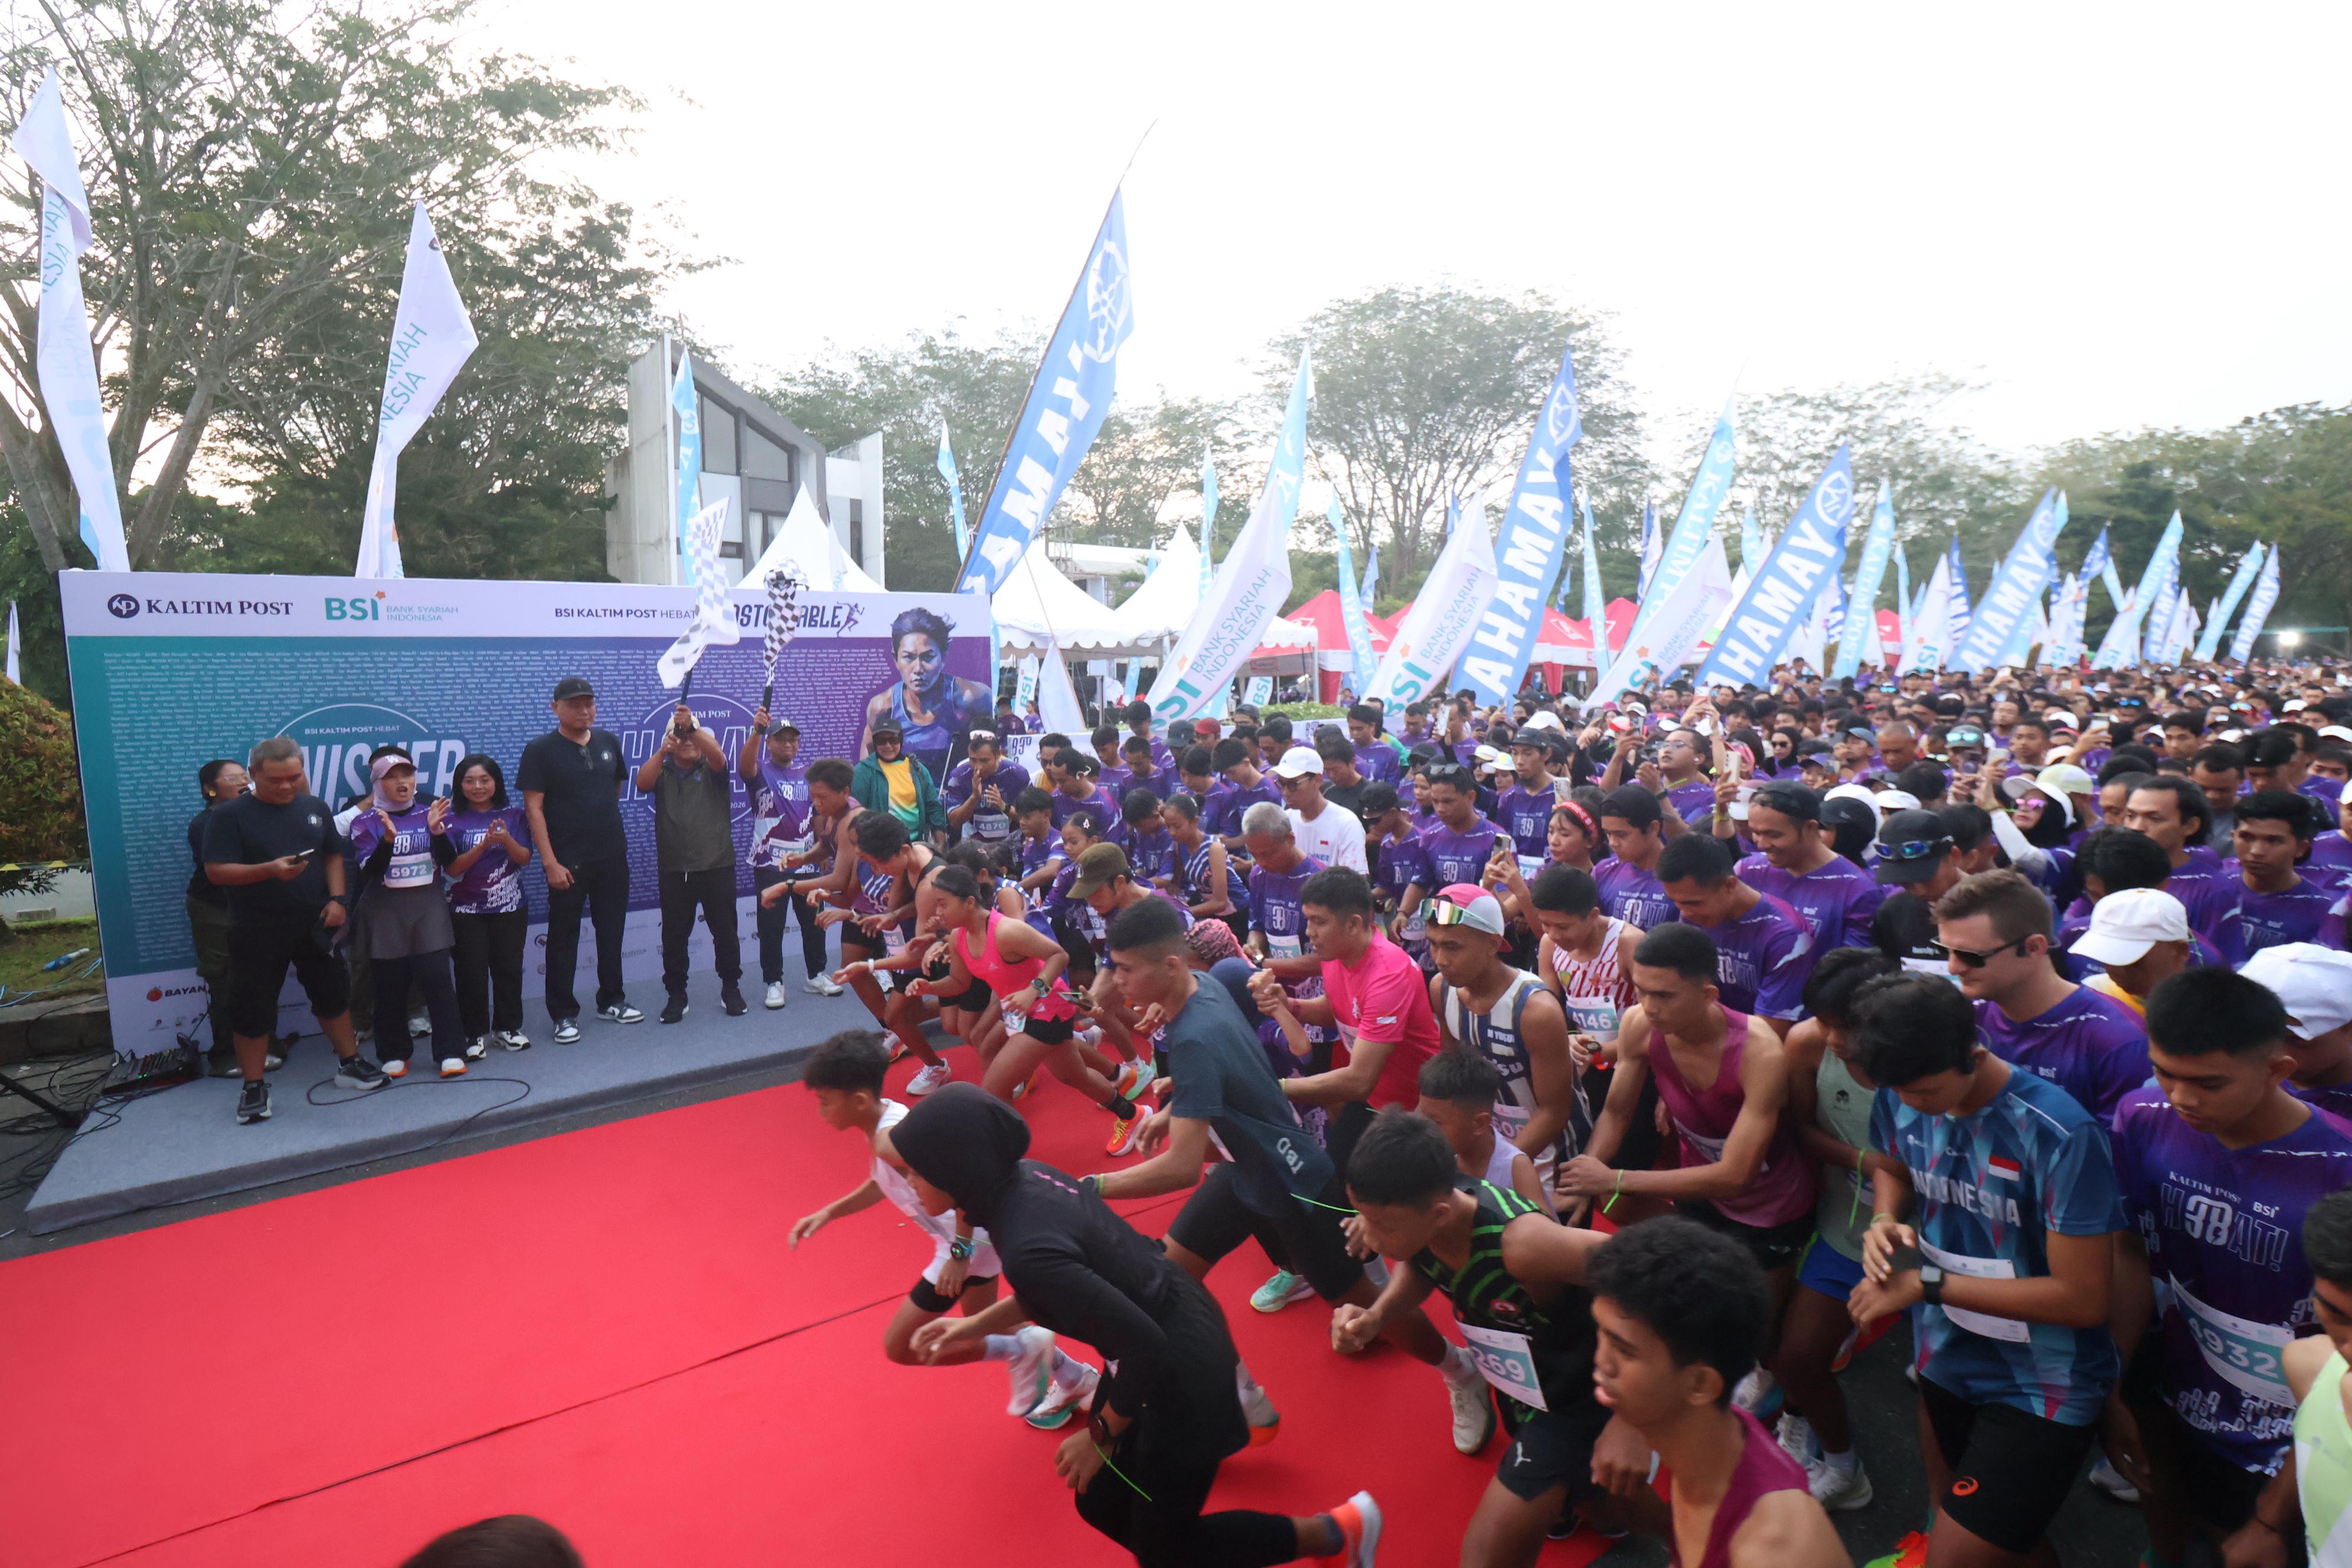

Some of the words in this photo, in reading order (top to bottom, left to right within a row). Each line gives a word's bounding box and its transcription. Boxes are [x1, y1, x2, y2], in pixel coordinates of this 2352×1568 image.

[1665, 471, 1721, 580] KALTIM
[1853, 535, 1888, 617] KALTIM
[145, 599, 233, 614] KALTIM
[239, 601, 293, 615] POST
[325, 597, 379, 620] BSI
[386, 605, 414, 613] BANK
[417, 606, 459, 614] SYARIAH
[387, 613, 443, 622] INDONESIA
[555, 607, 575, 618] BSI
[577, 607, 623, 619] KALTIM
[626, 609, 658, 619] POST
[660, 609, 697, 620] HEBAT
[1420, 623, 1451, 660] BANK
[1443, 567, 1482, 622] SYARIAH
[1190, 631, 1226, 674] BANK
[1221, 569, 1271, 634] SYARIAH
[1431, 596, 1480, 665] INDONESIA
[1202, 604, 1266, 681] INDONESIA
[1657, 633, 1683, 661] BANK
[1665, 612, 1710, 665] INDONESIA
[1843, 616, 1868, 663] POST
[1020, 676, 1033, 708] BSI
[1252, 676, 1271, 705] BSI
[708, 710, 731, 718] POST
[385, 755, 398, 764] LA
[1572, 1011, 1612, 1030] 4146
[2169, 1170, 2212, 1194] KALTIM
[2252, 1201, 2280, 1219] BSI
